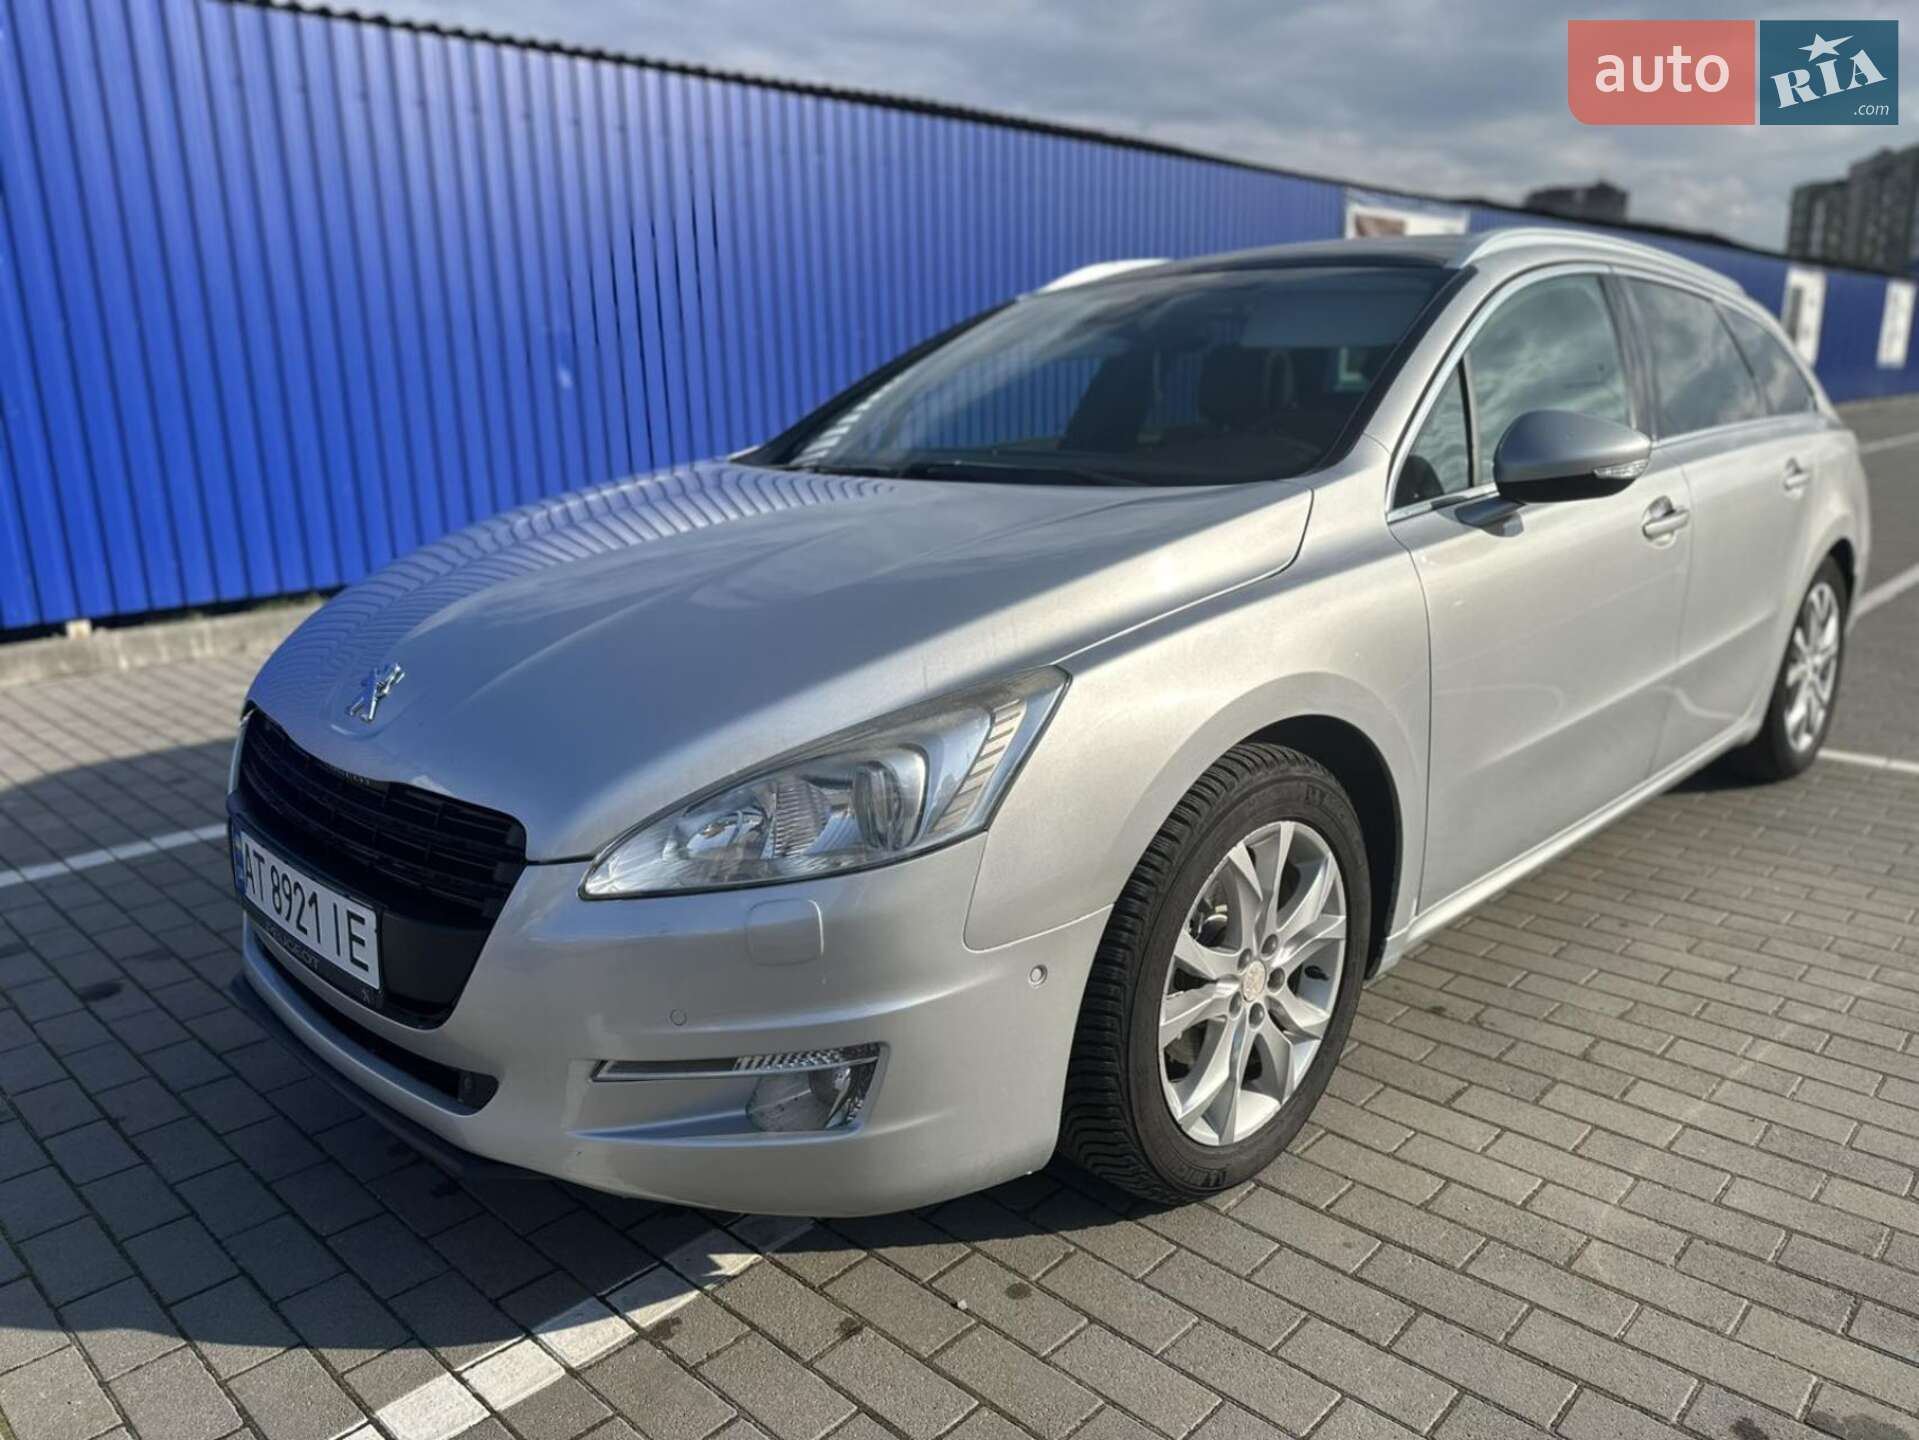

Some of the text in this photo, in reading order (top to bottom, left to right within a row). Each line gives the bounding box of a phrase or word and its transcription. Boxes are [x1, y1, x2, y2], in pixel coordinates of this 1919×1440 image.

[244, 843, 369, 973] AT 8921 IE
